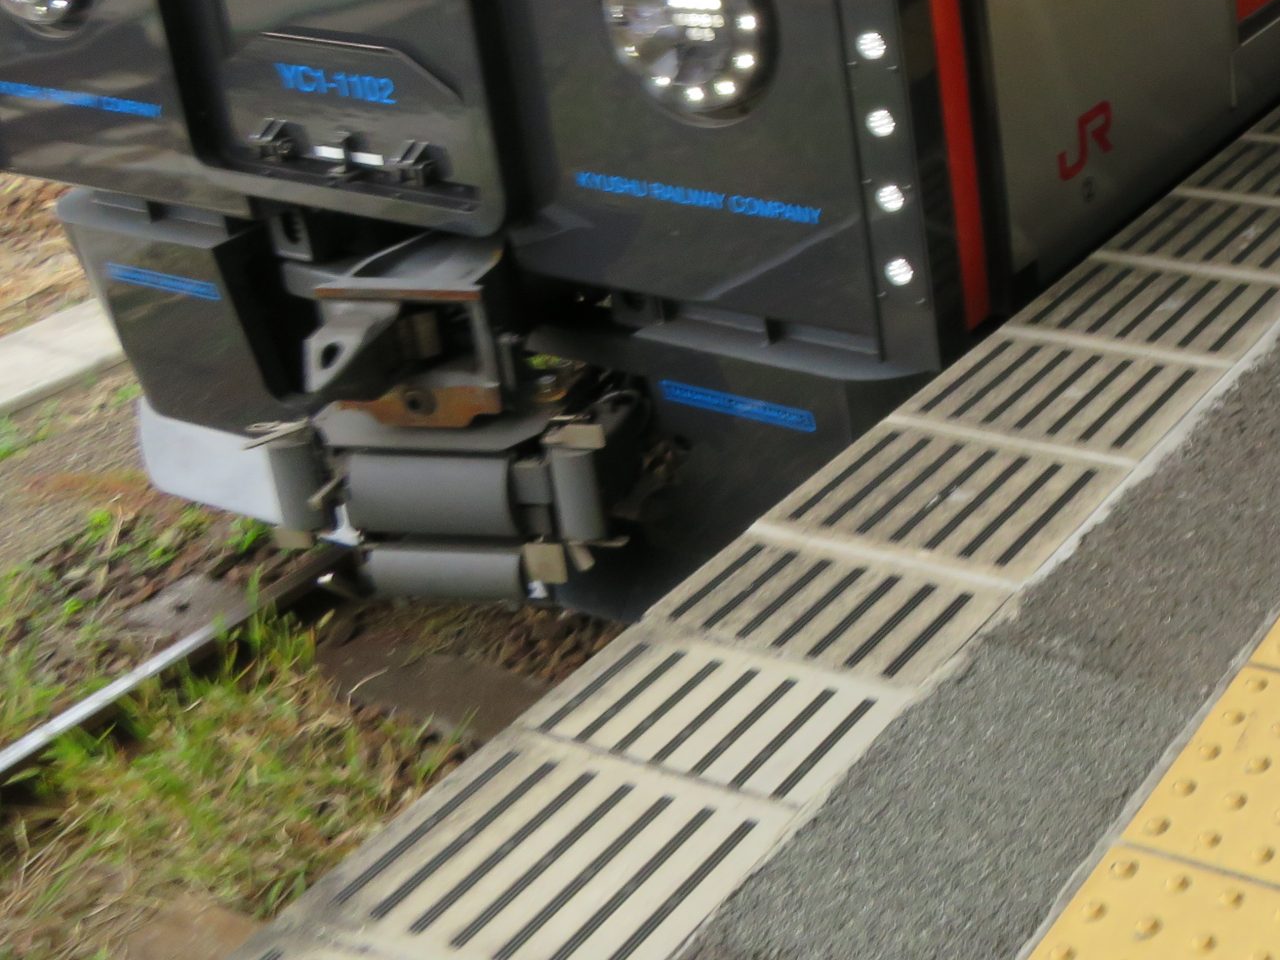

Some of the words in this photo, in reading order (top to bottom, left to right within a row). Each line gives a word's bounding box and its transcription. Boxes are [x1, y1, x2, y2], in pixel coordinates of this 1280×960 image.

[273, 62, 397, 105] YC1-1102
[1057, 99, 1114, 182] JR
[726, 194, 823, 225] COMPANY
